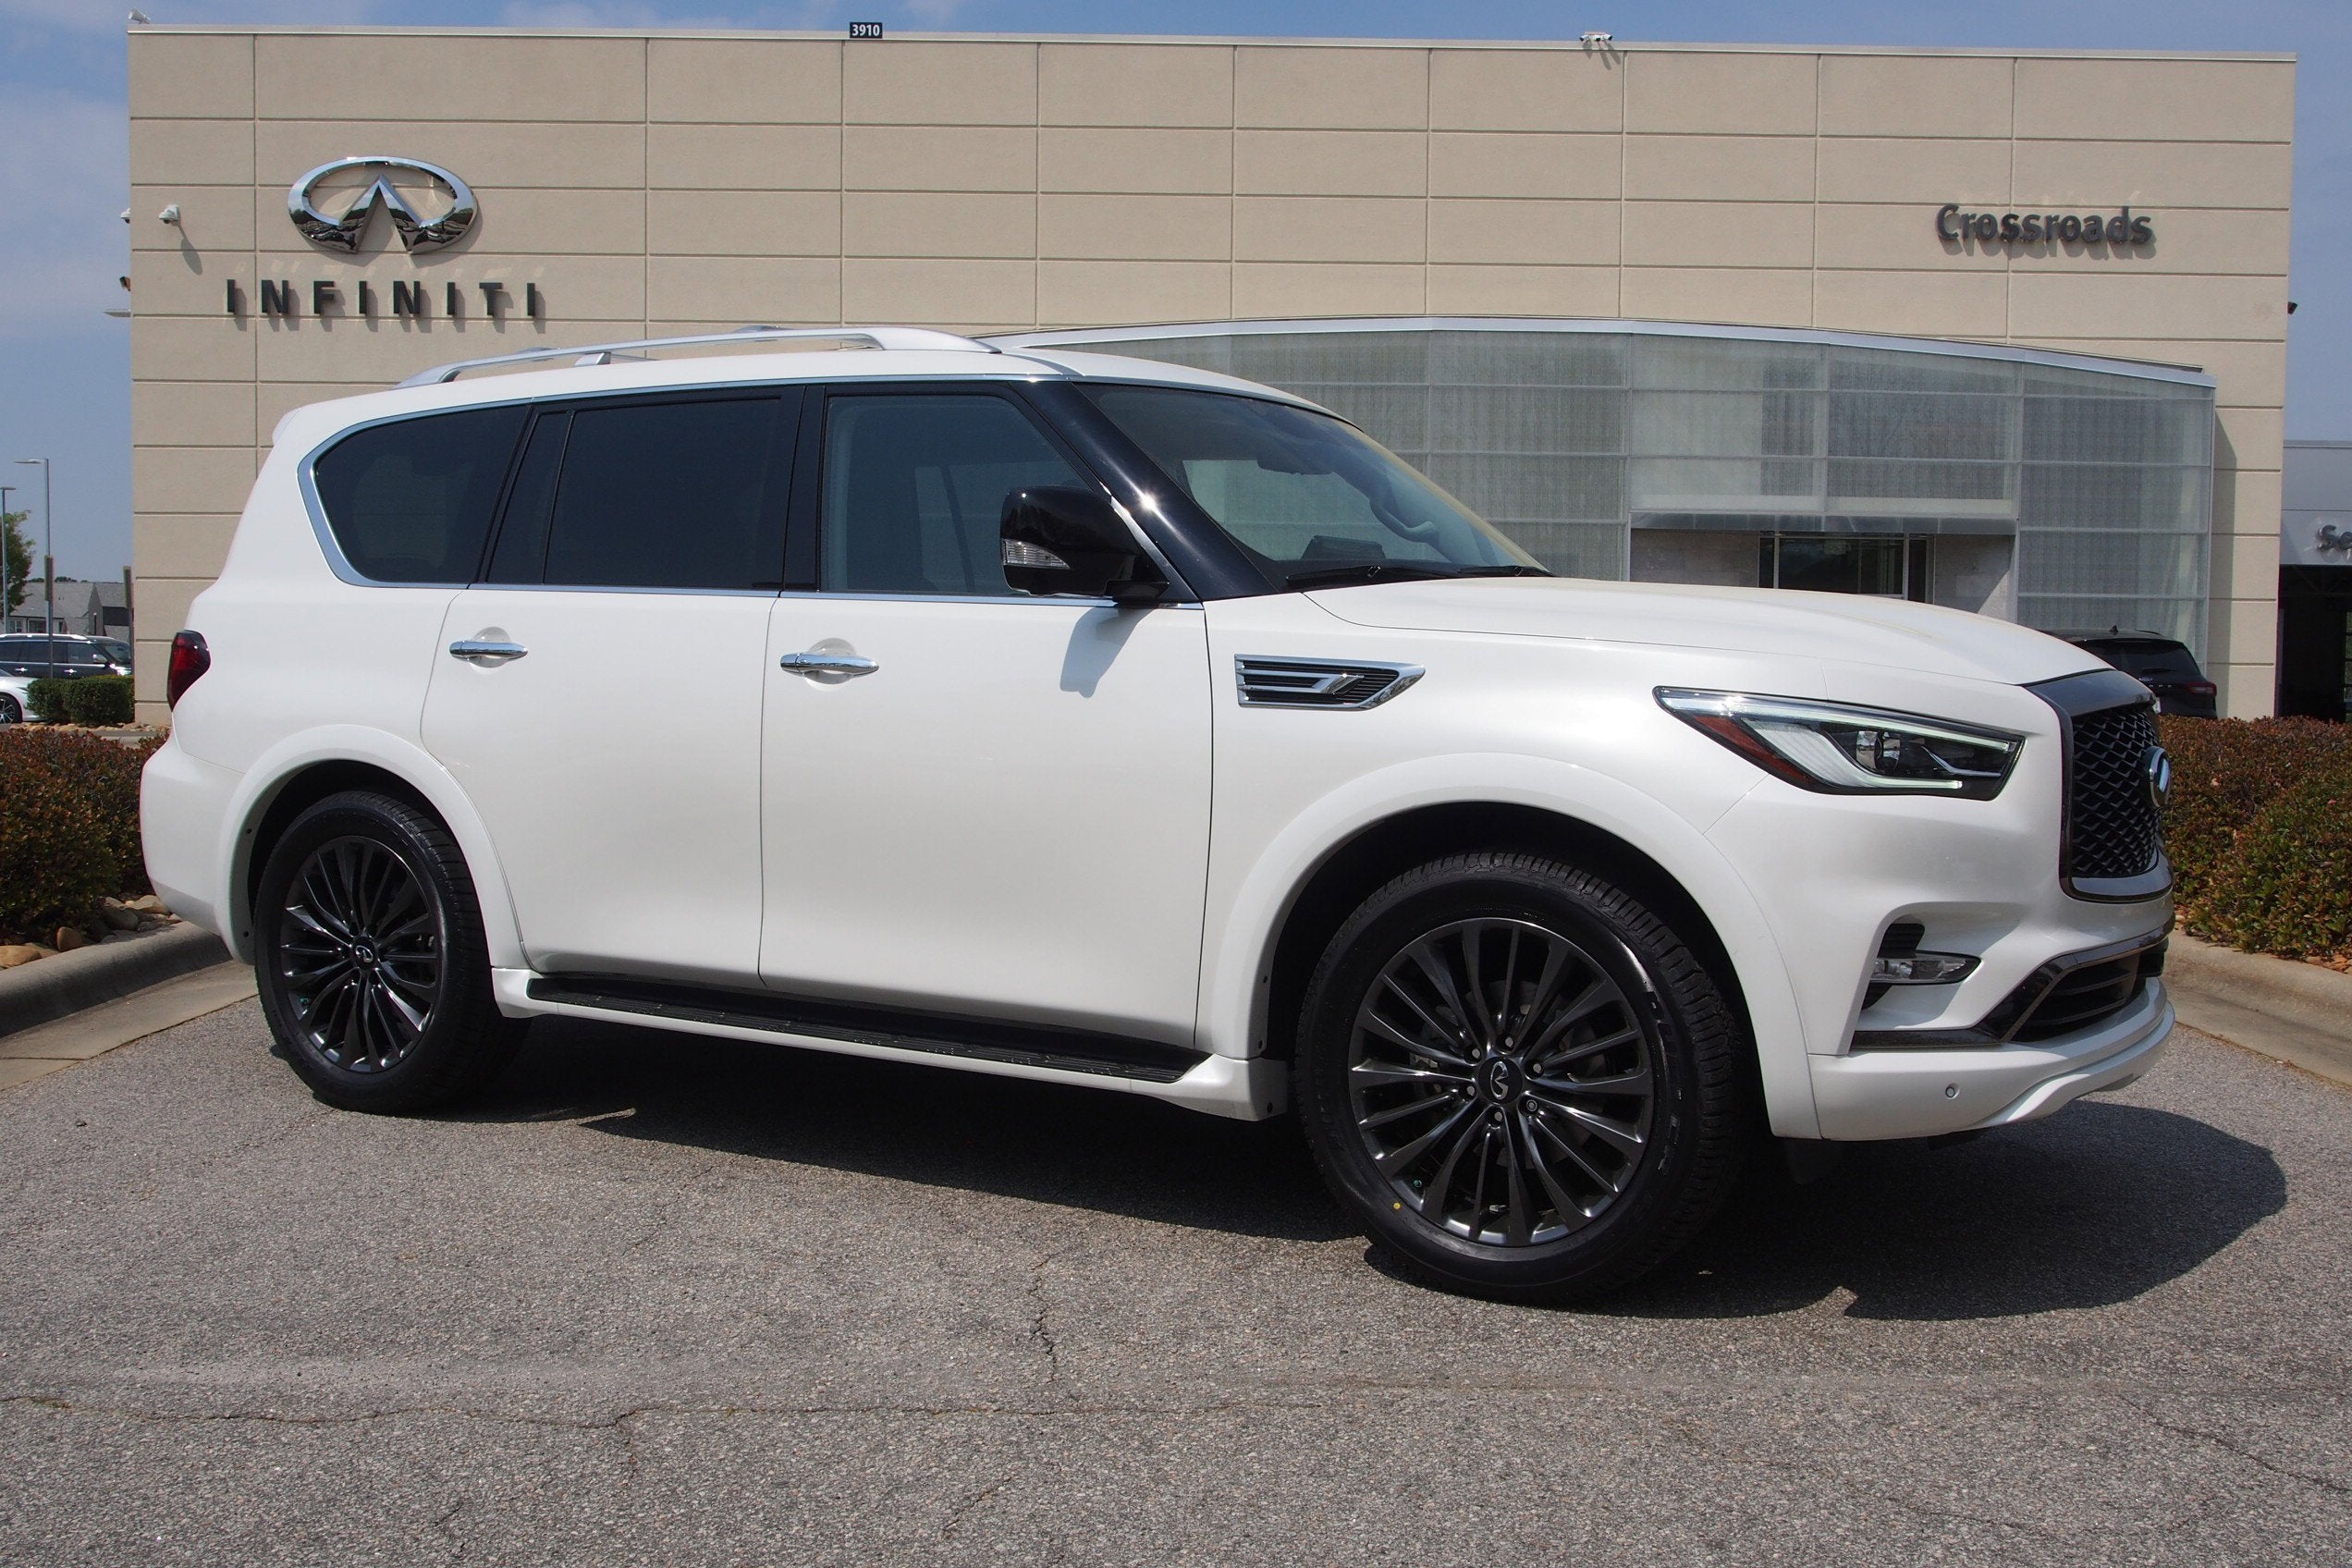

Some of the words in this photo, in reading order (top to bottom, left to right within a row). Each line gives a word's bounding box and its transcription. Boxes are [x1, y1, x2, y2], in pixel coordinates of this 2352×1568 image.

[851, 23, 881, 37] 3910
[1936, 203, 2153, 244] Crossroads
[227, 278, 535, 317] INFINITI
